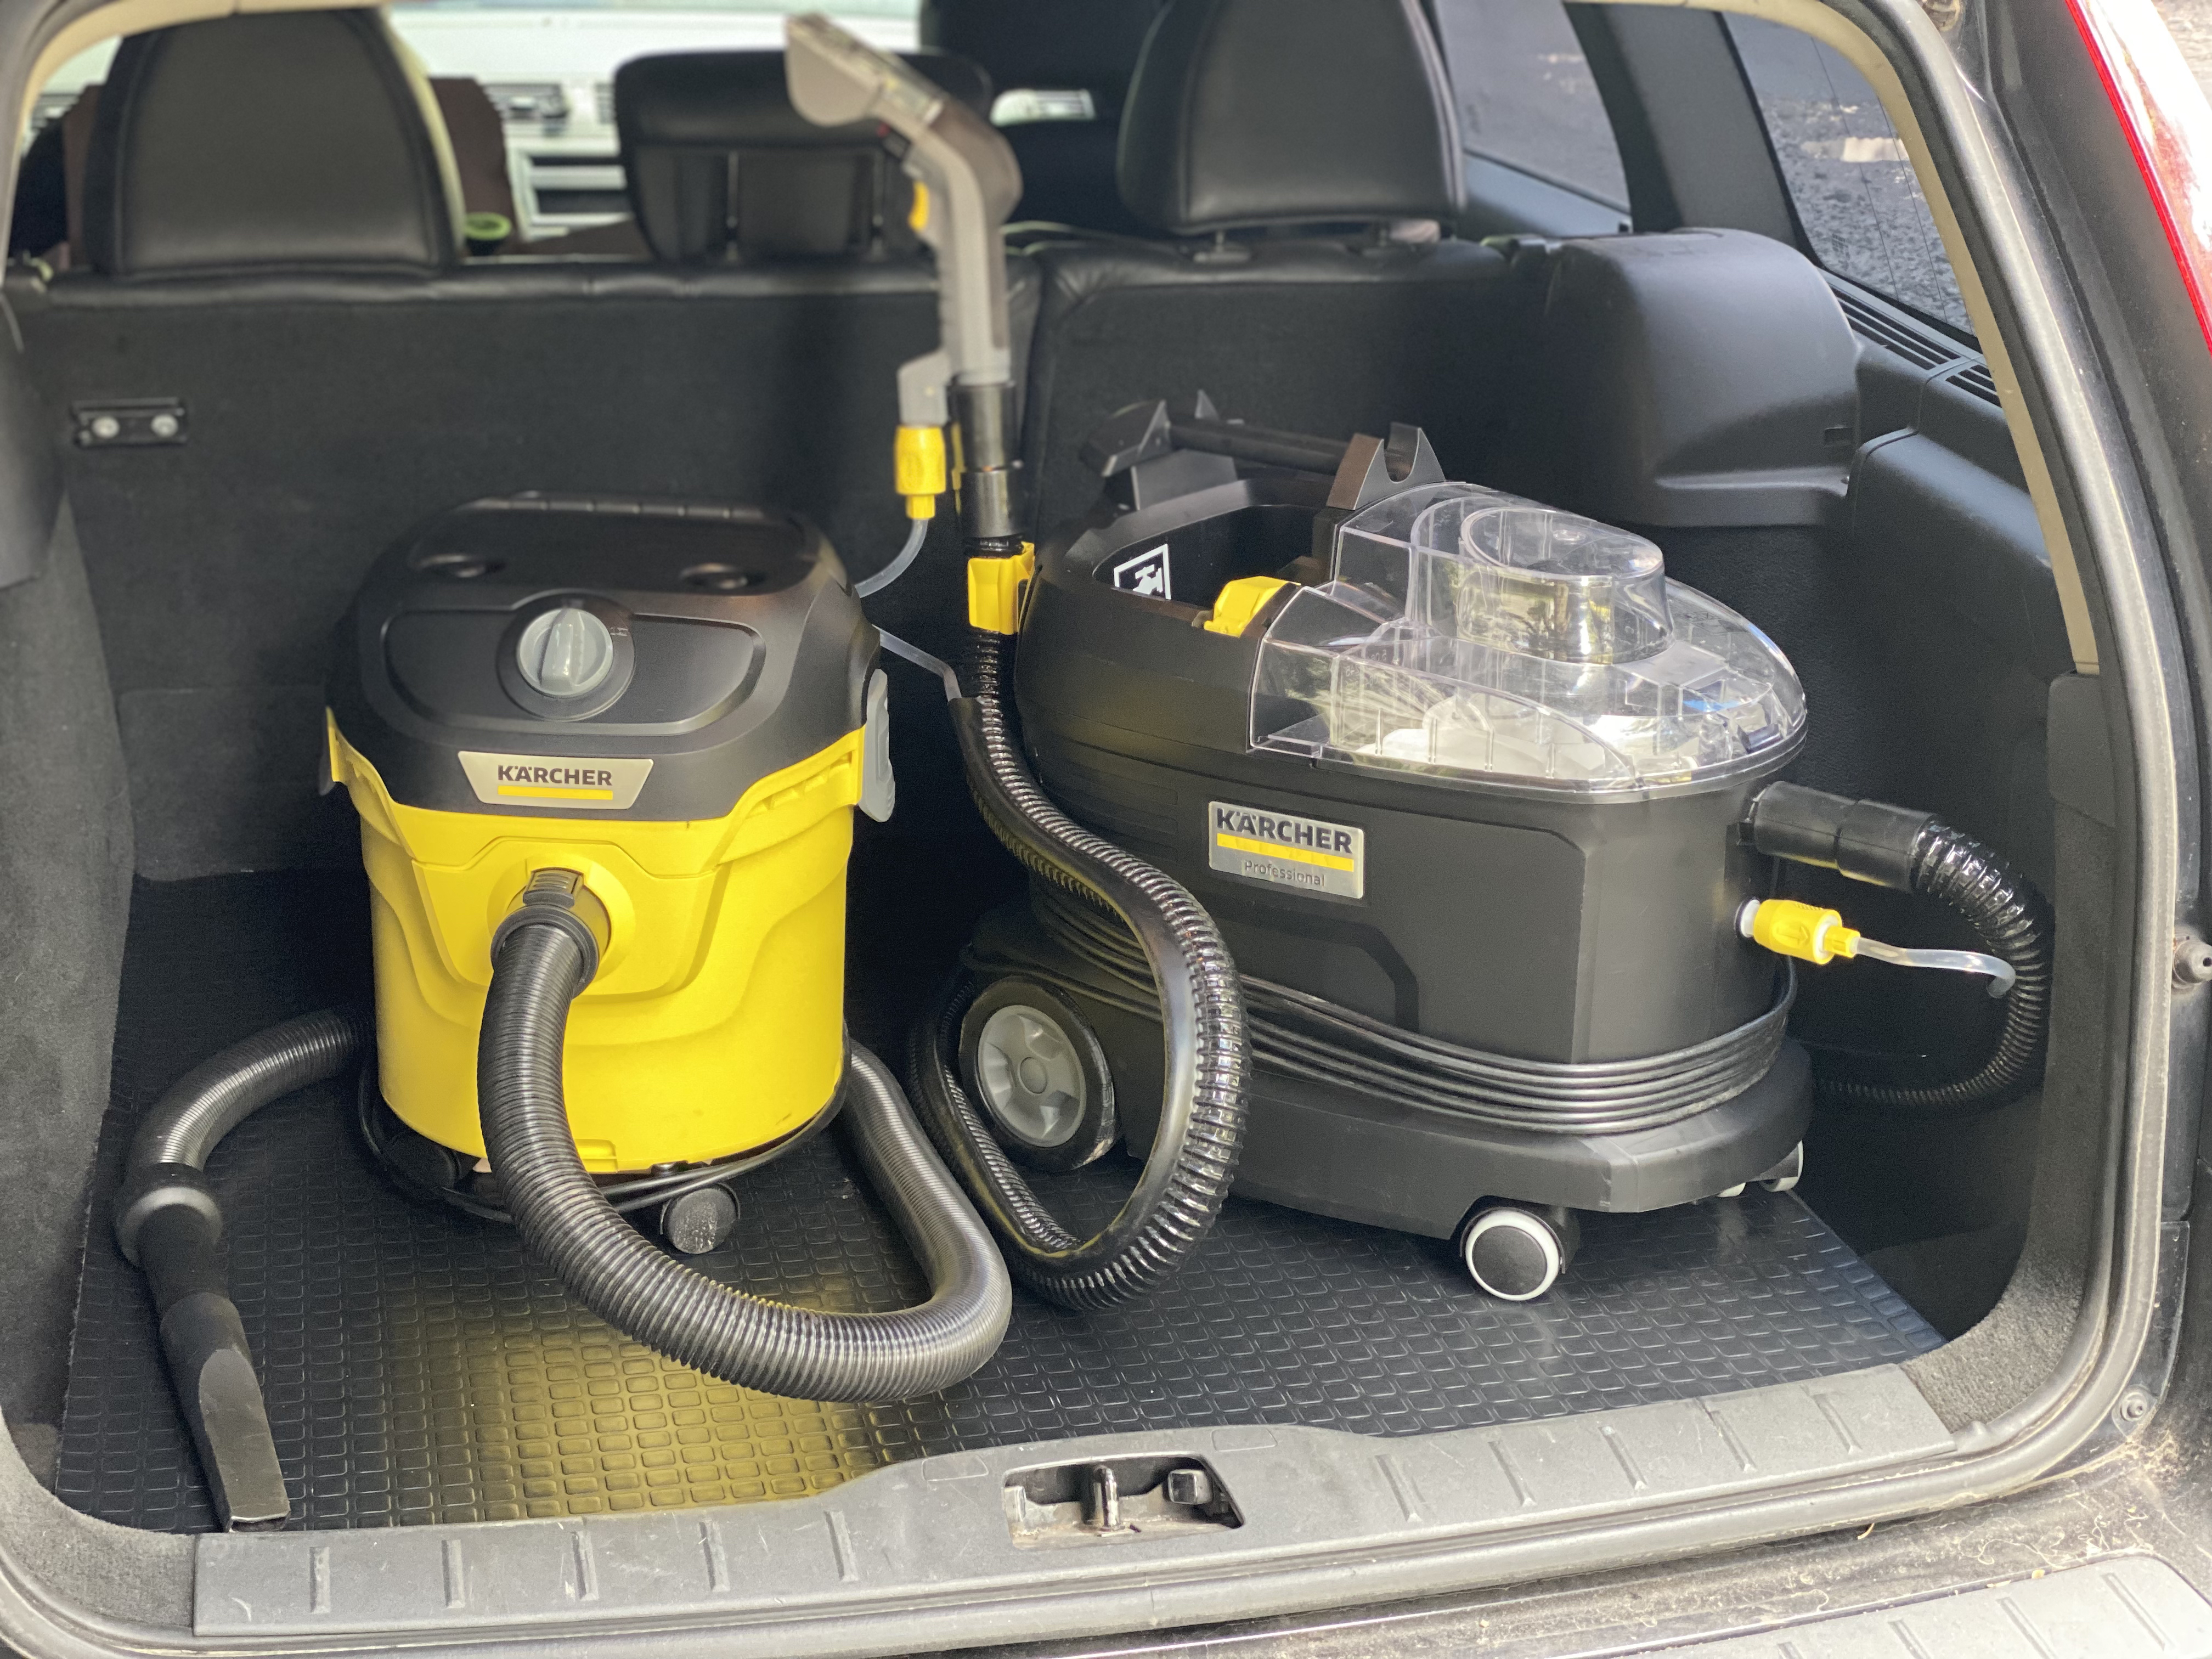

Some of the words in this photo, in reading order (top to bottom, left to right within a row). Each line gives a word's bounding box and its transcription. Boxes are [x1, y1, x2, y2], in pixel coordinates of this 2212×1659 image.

[498, 765, 612, 786] KÄRCHER
[1217, 808, 1352, 854] KÄRCHER
[1244, 860, 1325, 887] Professional
